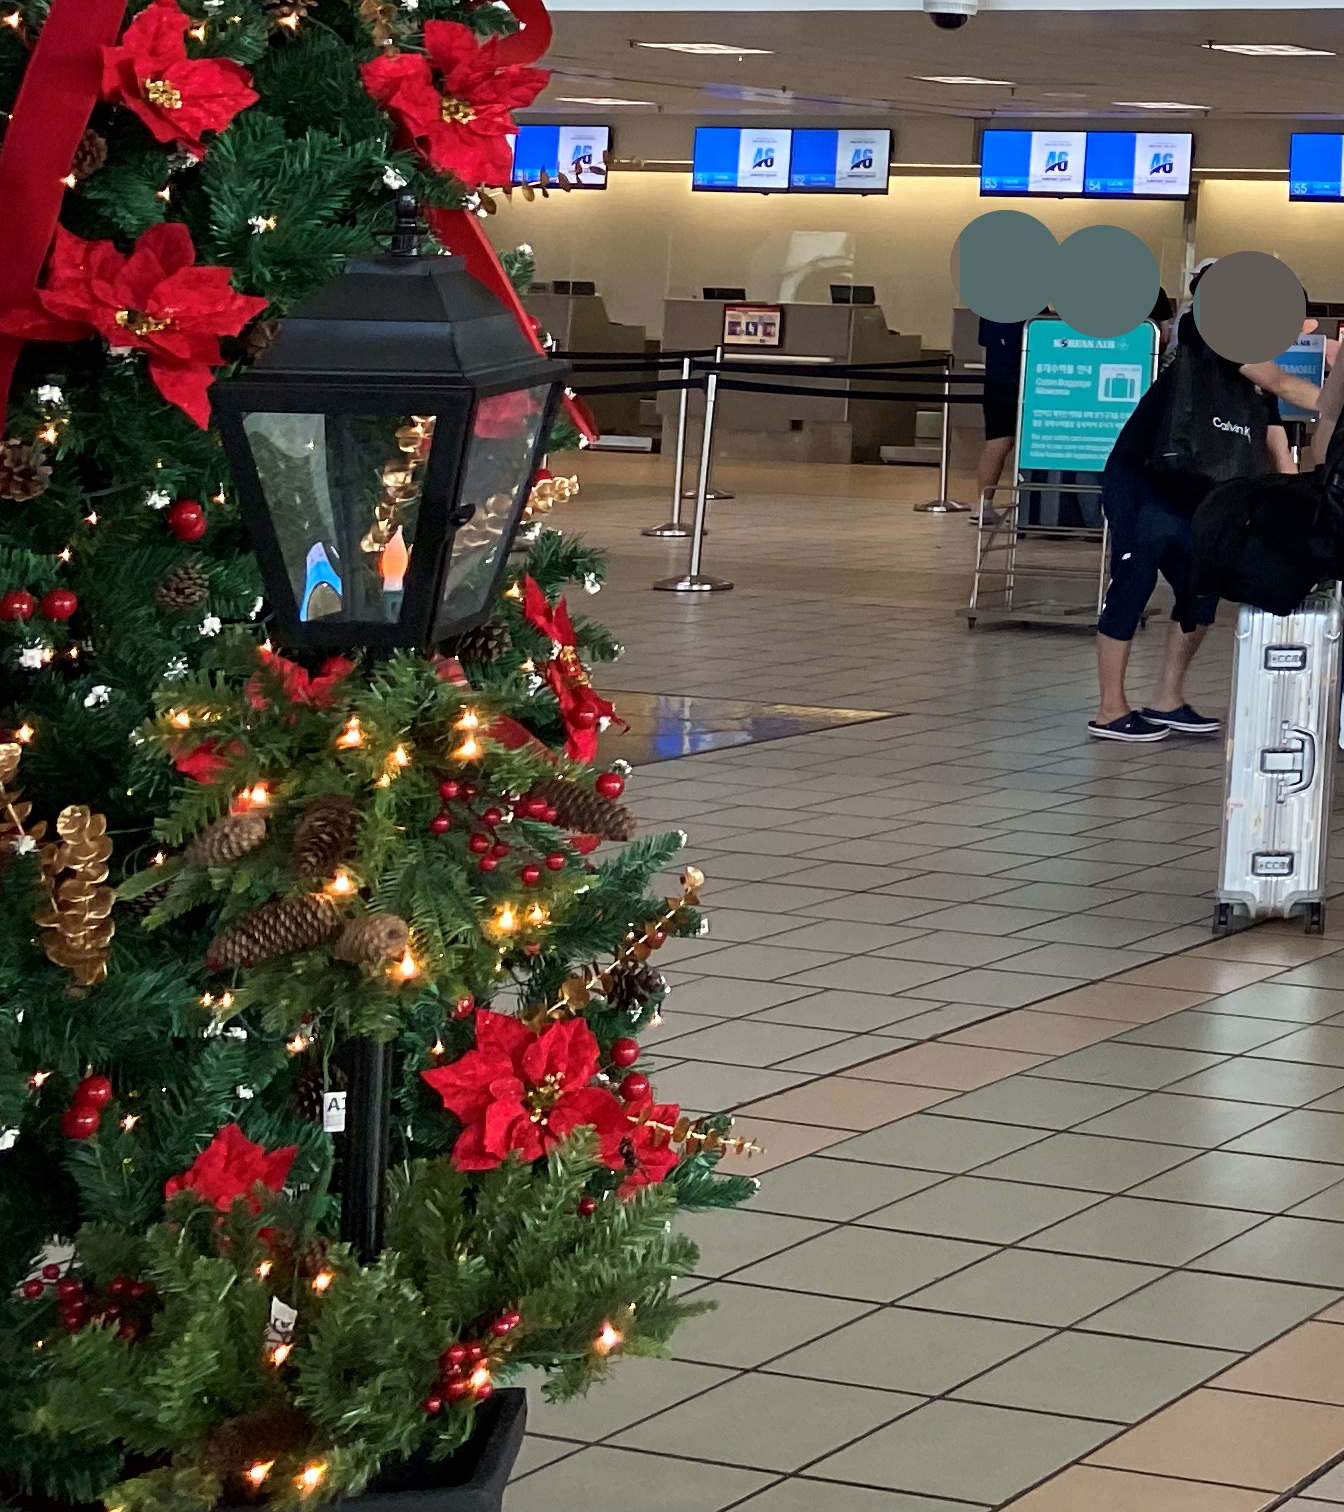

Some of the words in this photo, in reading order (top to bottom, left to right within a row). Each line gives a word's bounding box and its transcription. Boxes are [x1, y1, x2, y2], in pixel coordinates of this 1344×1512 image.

[1294, 183, 1308, 194] 55
[1053, 339, 1094, 348] KOREAN
[1095, 340, 1116, 349] AIR
[1212, 416, 1244, 435] Calvin
